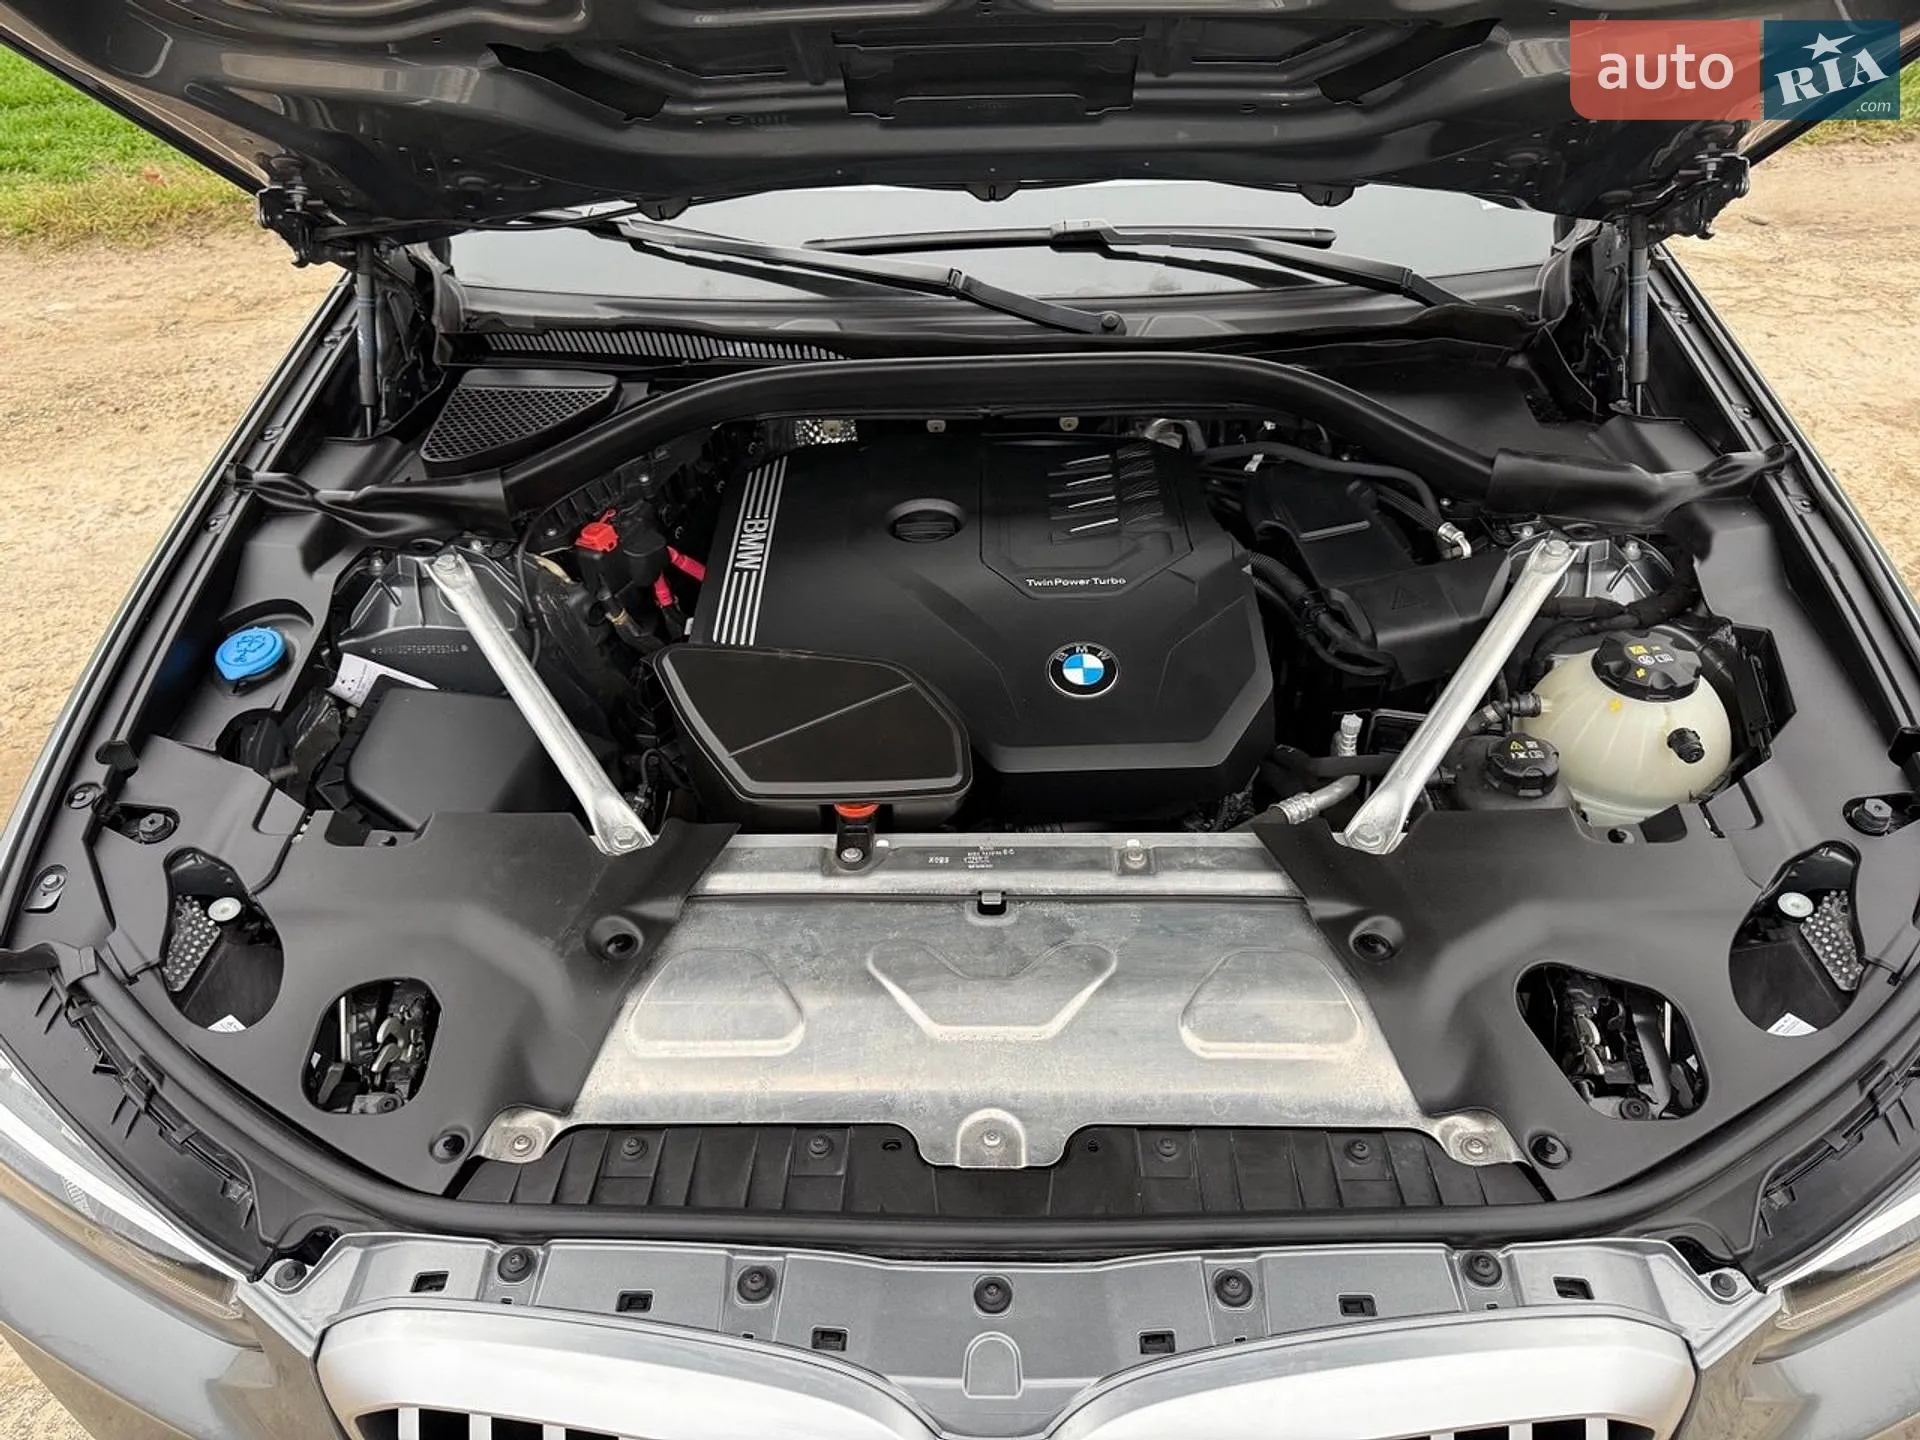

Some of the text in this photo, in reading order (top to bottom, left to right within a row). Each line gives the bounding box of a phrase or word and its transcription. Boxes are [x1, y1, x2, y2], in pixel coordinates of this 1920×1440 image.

[734, 519, 769, 570] BMW
[1091, 577, 1127, 585] Turbo
[1055, 645, 1112, 662] BMW
